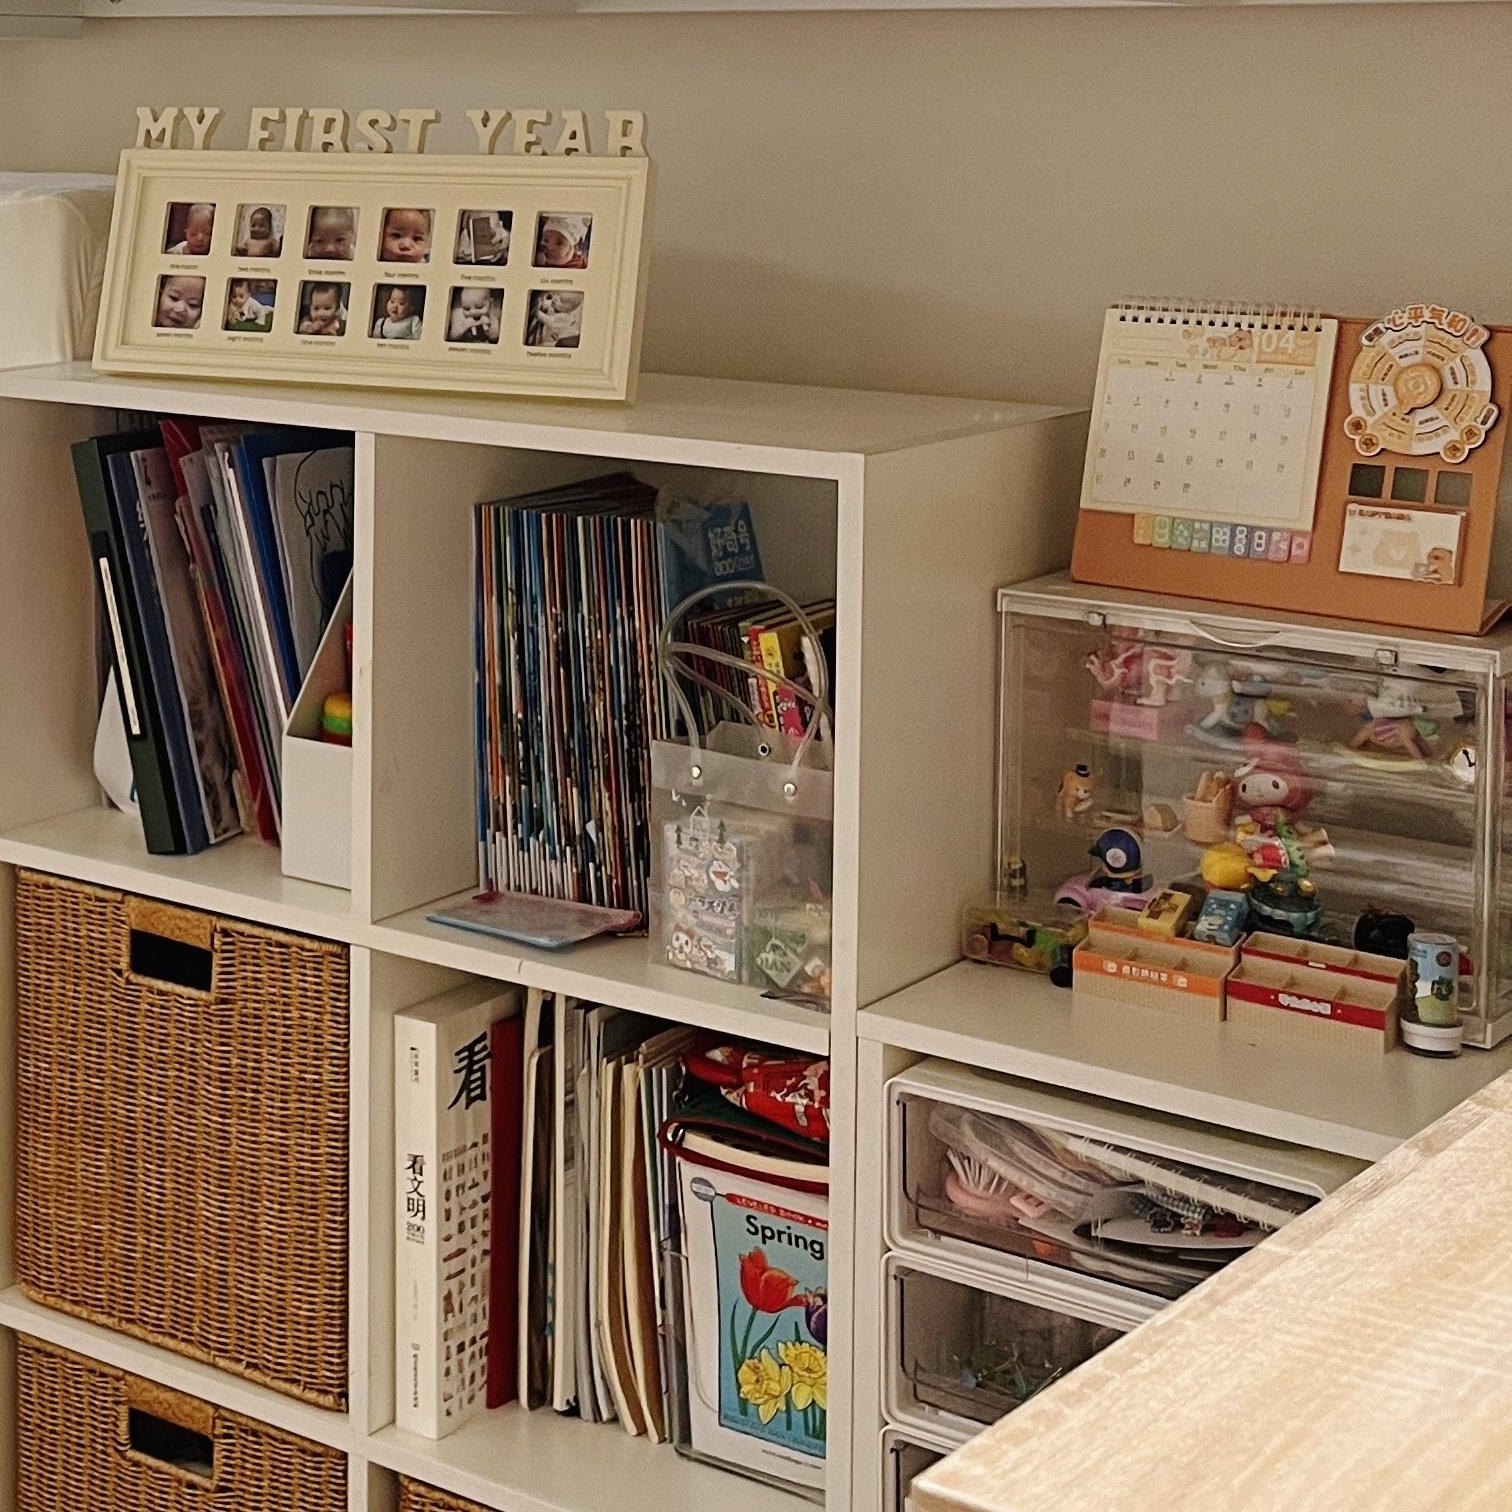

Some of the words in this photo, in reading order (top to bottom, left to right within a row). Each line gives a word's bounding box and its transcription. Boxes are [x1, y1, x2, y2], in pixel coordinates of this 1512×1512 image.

[135, 106, 222, 151] MY
[247, 107, 441, 155] FIRST
[465, 108, 648, 158] YEAR
[1261, 330, 1297, 353] 04
[447, 1030, 493, 1111] 看
[404, 1153, 427, 1221] 看文明
[745, 1214, 825, 1261] Spring
